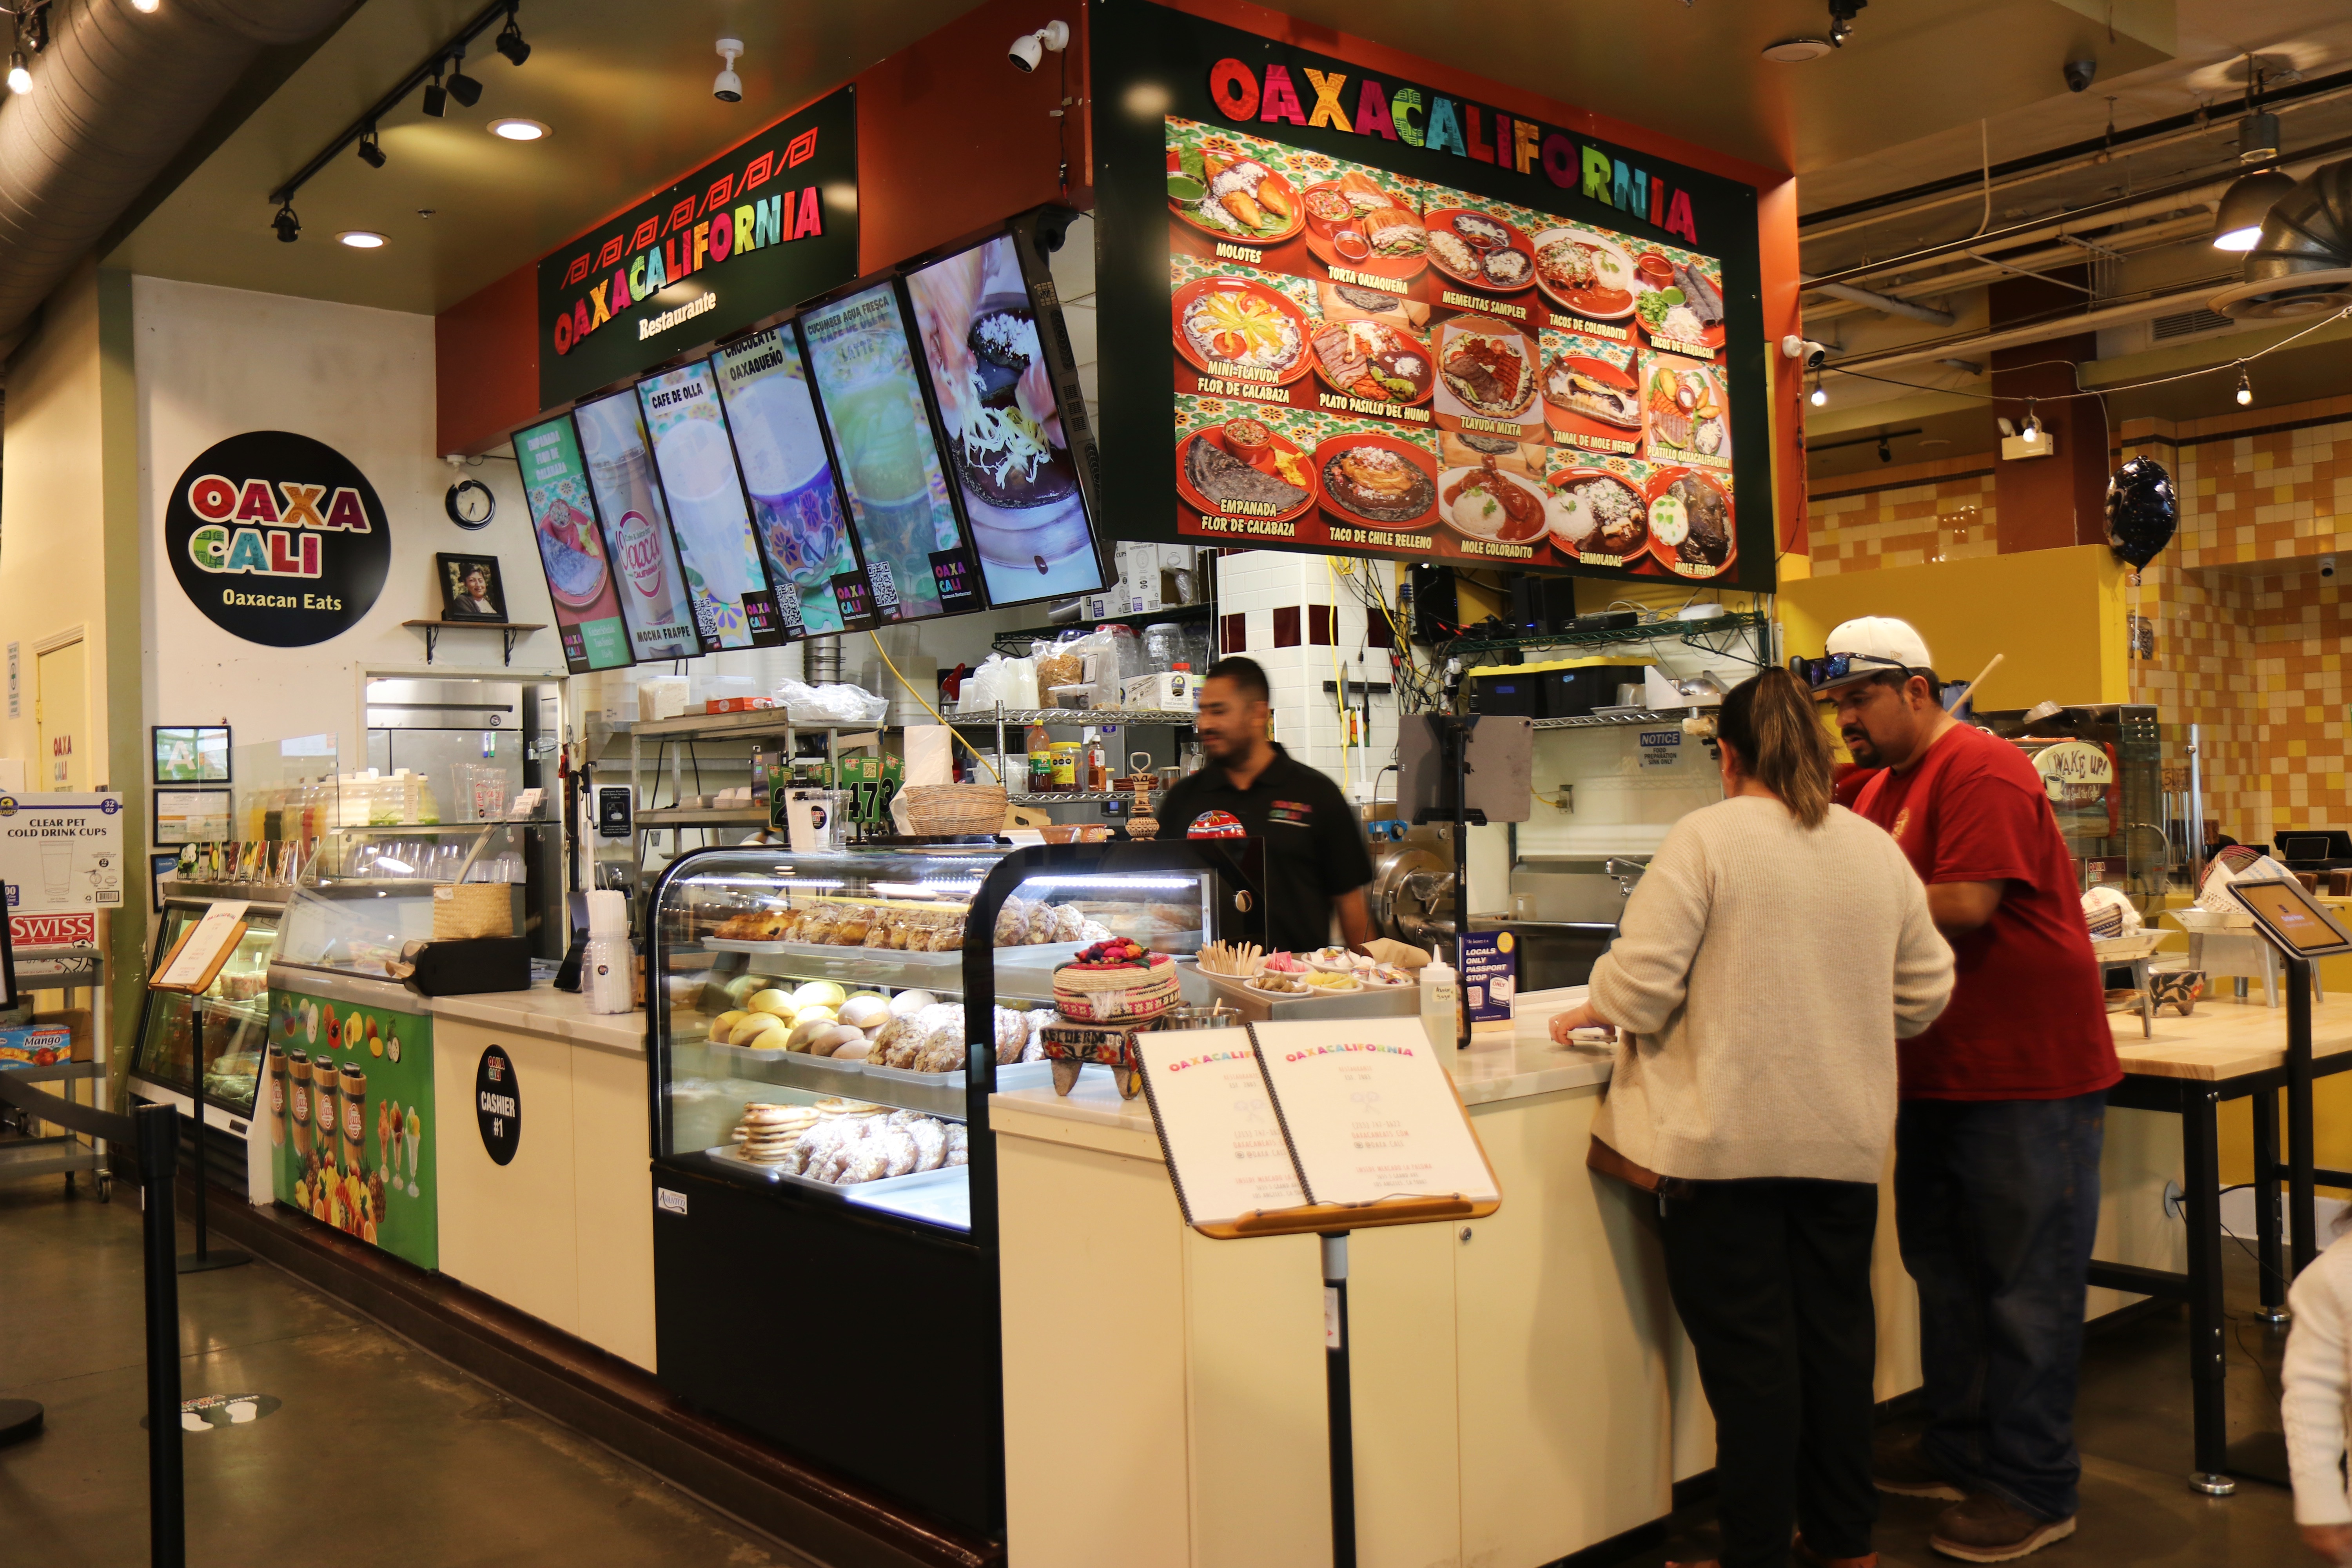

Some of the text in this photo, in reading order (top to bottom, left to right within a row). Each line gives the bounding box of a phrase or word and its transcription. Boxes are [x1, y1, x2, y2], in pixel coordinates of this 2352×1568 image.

[1210, 57, 1697, 245] OAXACALIFORNIA
[1216, 242, 1262, 263] MOLOTES
[554, 186, 822, 355] OAXACALIFORNIA
[1328, 266, 1408, 294] TORTA OAXAQUEÑA
[639, 291, 717, 341] Restaurante
[808, 296, 889, 335] CUCUMBER AGUA FRESCA
[1442, 290, 1526, 320] MEMELITAS SAMPLER
[1549, 314, 1627, 340] TACOS DE COLORADITO
[725, 330, 777, 358] CHOCOLATE
[841, 338, 874, 362] LATTE
[1650, 336, 1715, 360] TACOS DE BARBACOA
[730, 346, 783, 381] OAXAQUEÑO
[1207, 361, 1279, 384] MINI-TLAYUDA
[652, 383, 703, 409] CAFE DE OLLA
[1198, 377, 1290, 403] FLOR DE CALABAZA
[1319, 394, 1430, 422] PLATO PASILLO DEL HUMO
[1461, 416, 1521, 437] TLAYUDA MIXTA
[1553, 430, 1635, 455] TAMAL DE MOLE NEGRO
[1647, 446, 1729, 469] PLATILLO OAXACALIFORNIA
[188, 474, 372, 534] OAXA
[1220, 499, 1277, 517] EMPANADA
[1201, 516, 1295, 537] FLOR DE CALABAZA
[1330, 527, 1432, 549] TACO DE CHILE RELLENO
[188, 525, 322, 579] CALI
[1461, 540, 1532, 559] MOLE COLORADITO
[1579, 552, 1622, 567] ENMOLADAS
[935, 562, 966, 578] OAXA
[1674, 562, 1716, 577] MOLE NEGRO
[837, 584, 865, 600] OAXA
[939, 578, 962, 592] CALI
[223, 589, 342, 611] Oaxacan Eats
[746, 602, 771, 615] OAXA
[841, 600, 862, 614] CALI
[750, 616, 768, 627] CALI
[637, 626, 691, 642] MOCHA FRAPPE
[54, 735, 71, 757] OAXA
[1642, 733, 1679, 744] NOTICE
[165, 740, 196, 770] A
[2053, 750, 2107, 779] WAKE UP!
[844, 782, 879, 819] 47
[42, 828, 76, 837] DRINK
[11, 917, 91, 938] SWISS
[1466, 964, 1506, 973] PASSPORT
[25, 1036, 60, 1046] Mango
[1043, 1030, 1105, 1044] RECUERDO
[488, 1056, 505, 1070] OAXA
[1169, 1051, 1257, 1071] OAXACALIF
[1286, 1043, 1413, 1062] OAXACALIFORNIA
[481, 1091, 515, 1117] CASHIER
[494, 1117, 503, 1137] #1
[660, 1191, 685, 1210] AVANTCO
